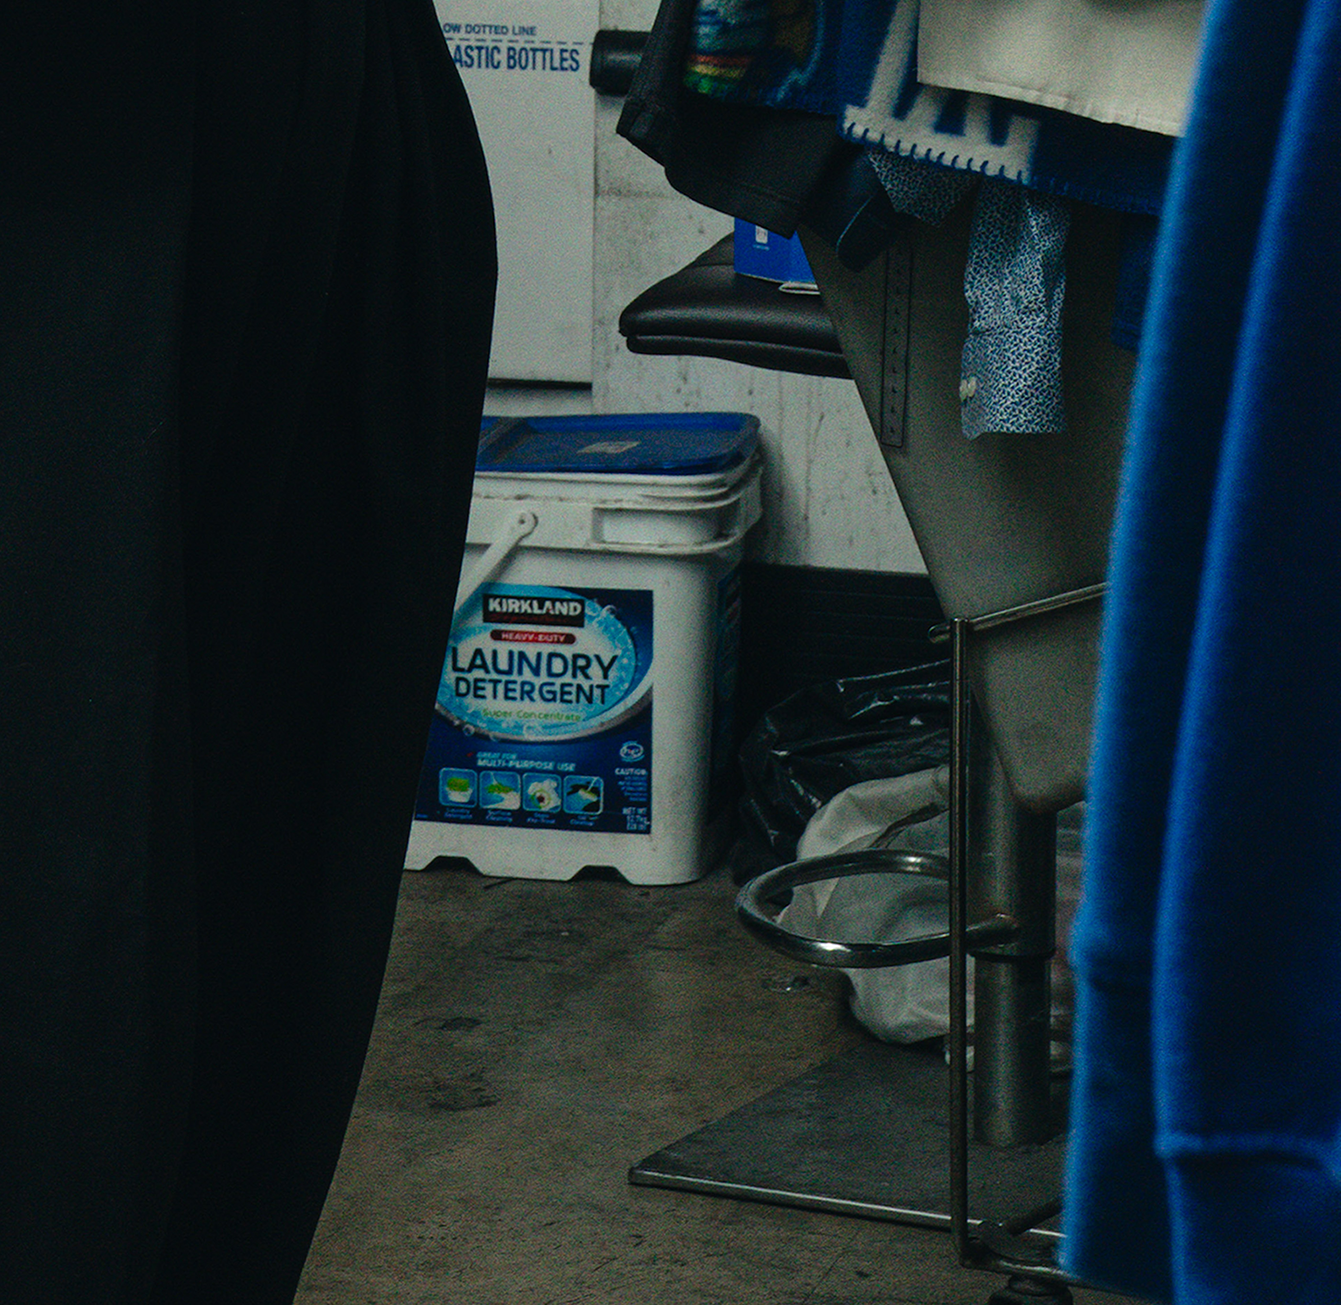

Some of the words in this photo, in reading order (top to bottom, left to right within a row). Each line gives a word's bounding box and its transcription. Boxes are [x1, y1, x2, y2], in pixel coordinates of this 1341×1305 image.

[443, 22, 461, 34] OW
[464, 23, 509, 36] DOTTED
[511, 25, 537, 37] LINE
[453, 44, 501, 70] ASTIC
[506, 46, 580, 73] BOTTLES
[488, 597, 583, 617] KIRKLAND
[501, 632, 567, 643] HEAVY-DUTY
[451, 645, 619, 681] LAUNDRY
[455, 676, 610, 705] DETERGENT
[482, 708, 513, 720] Super
[516, 710, 581, 722] Concentrate
[477, 759, 555, 771] MULTI-PURPOSE
[557, 762, 576, 772] USE
